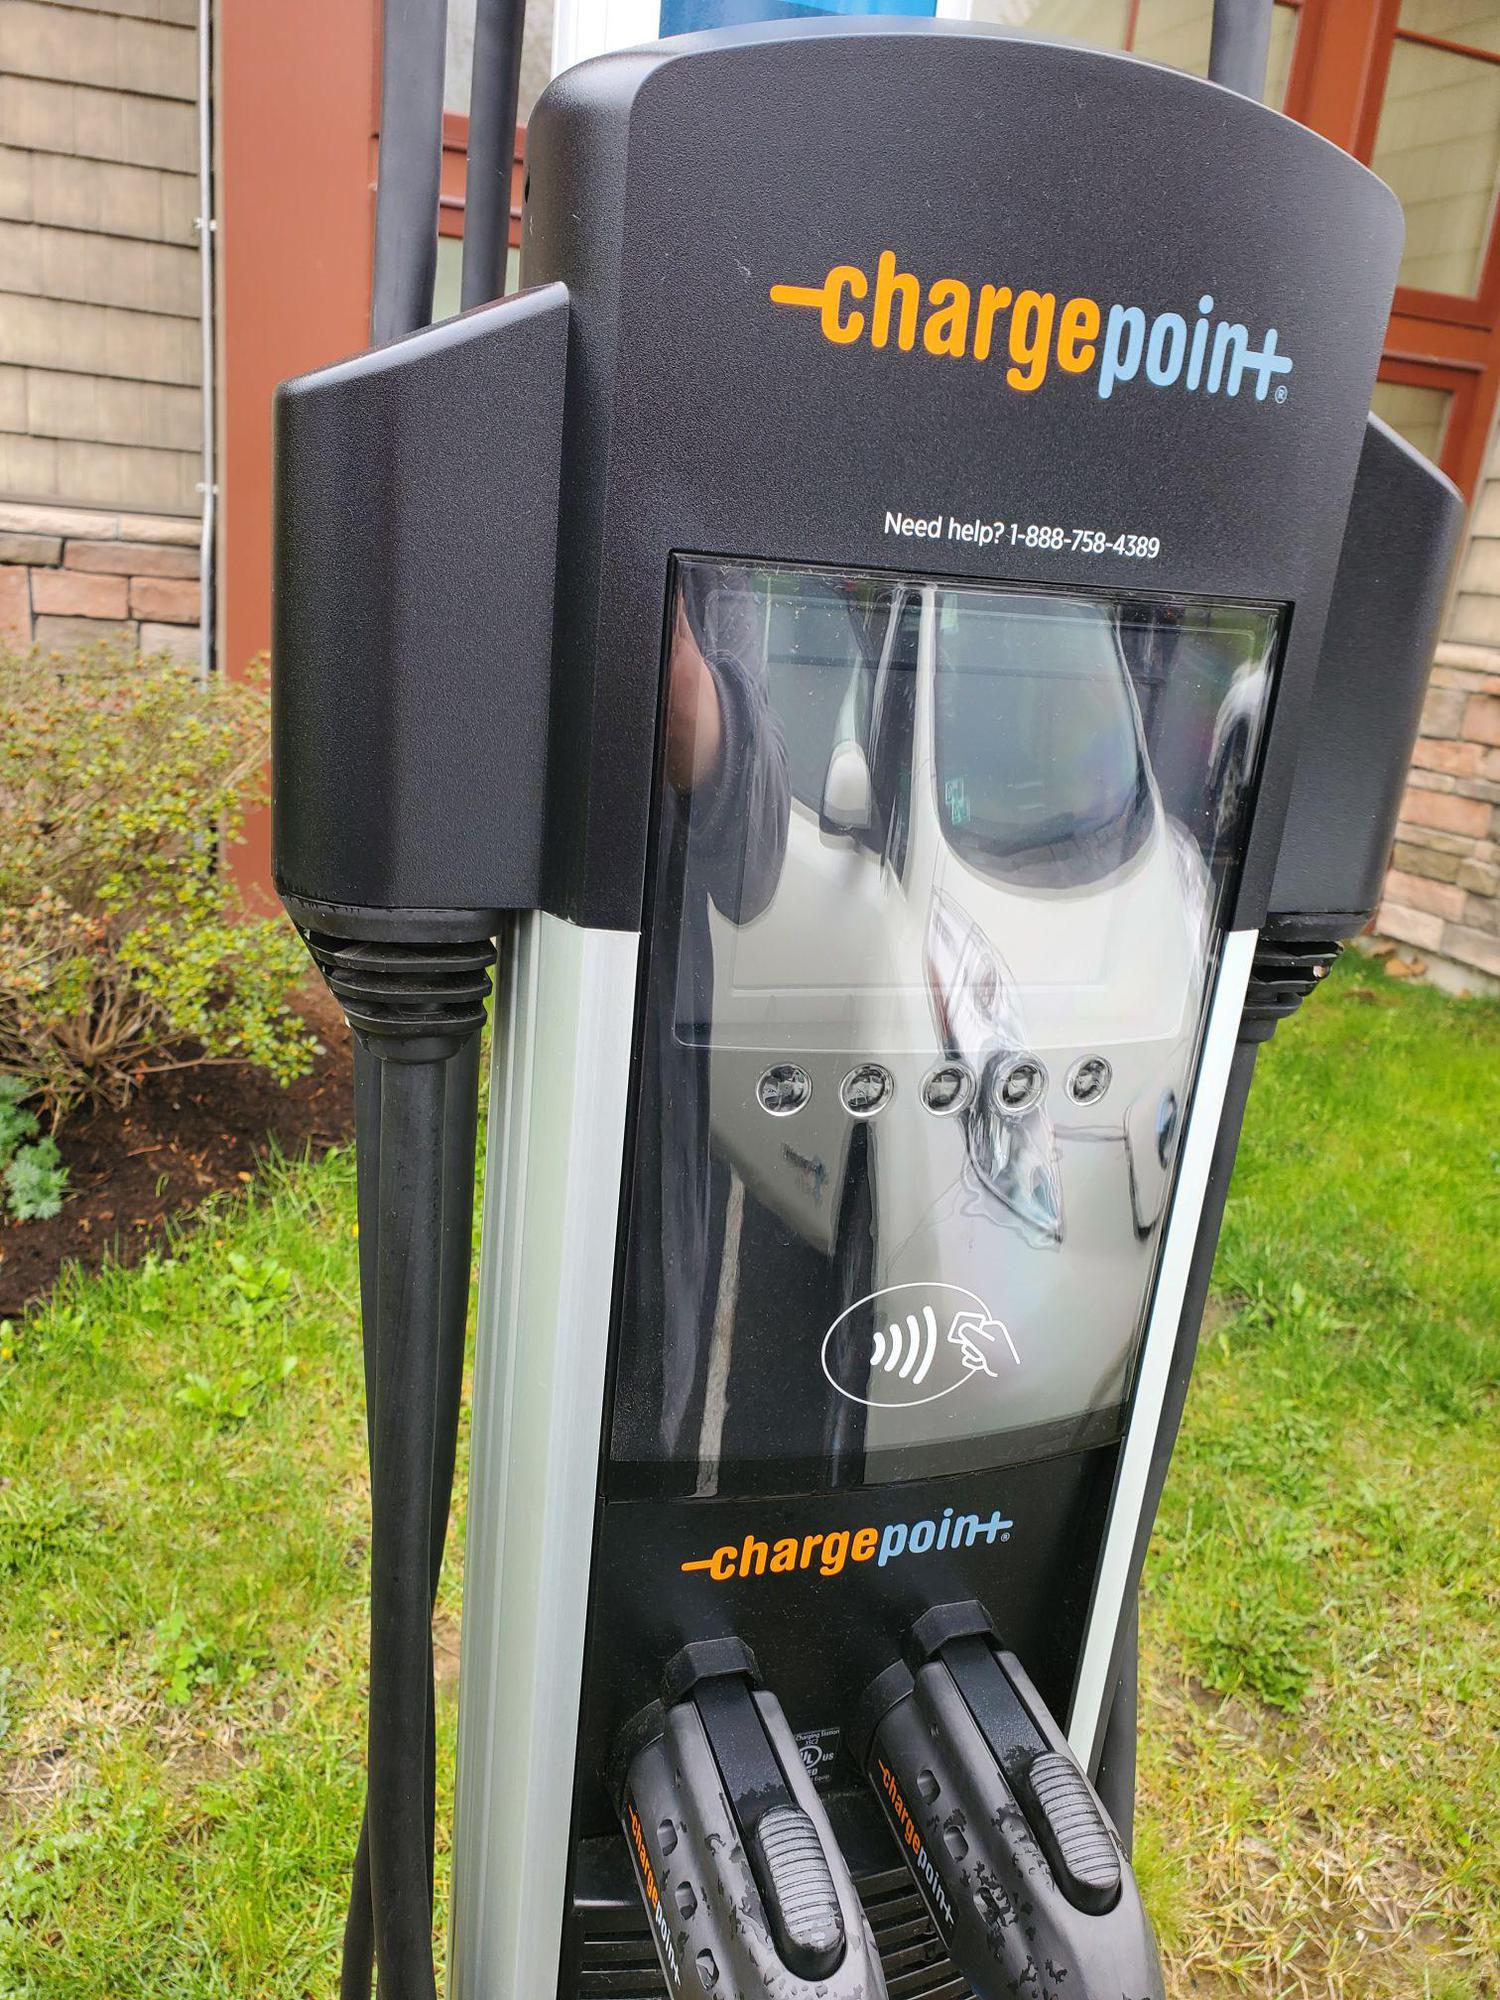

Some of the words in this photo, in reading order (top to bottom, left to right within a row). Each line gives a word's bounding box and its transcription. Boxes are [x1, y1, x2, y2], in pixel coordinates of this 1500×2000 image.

[884, 511, 942, 539] Need
[947, 517, 1004, 547] help?
[1010, 523, 1161, 559] 1-888-758-4389
